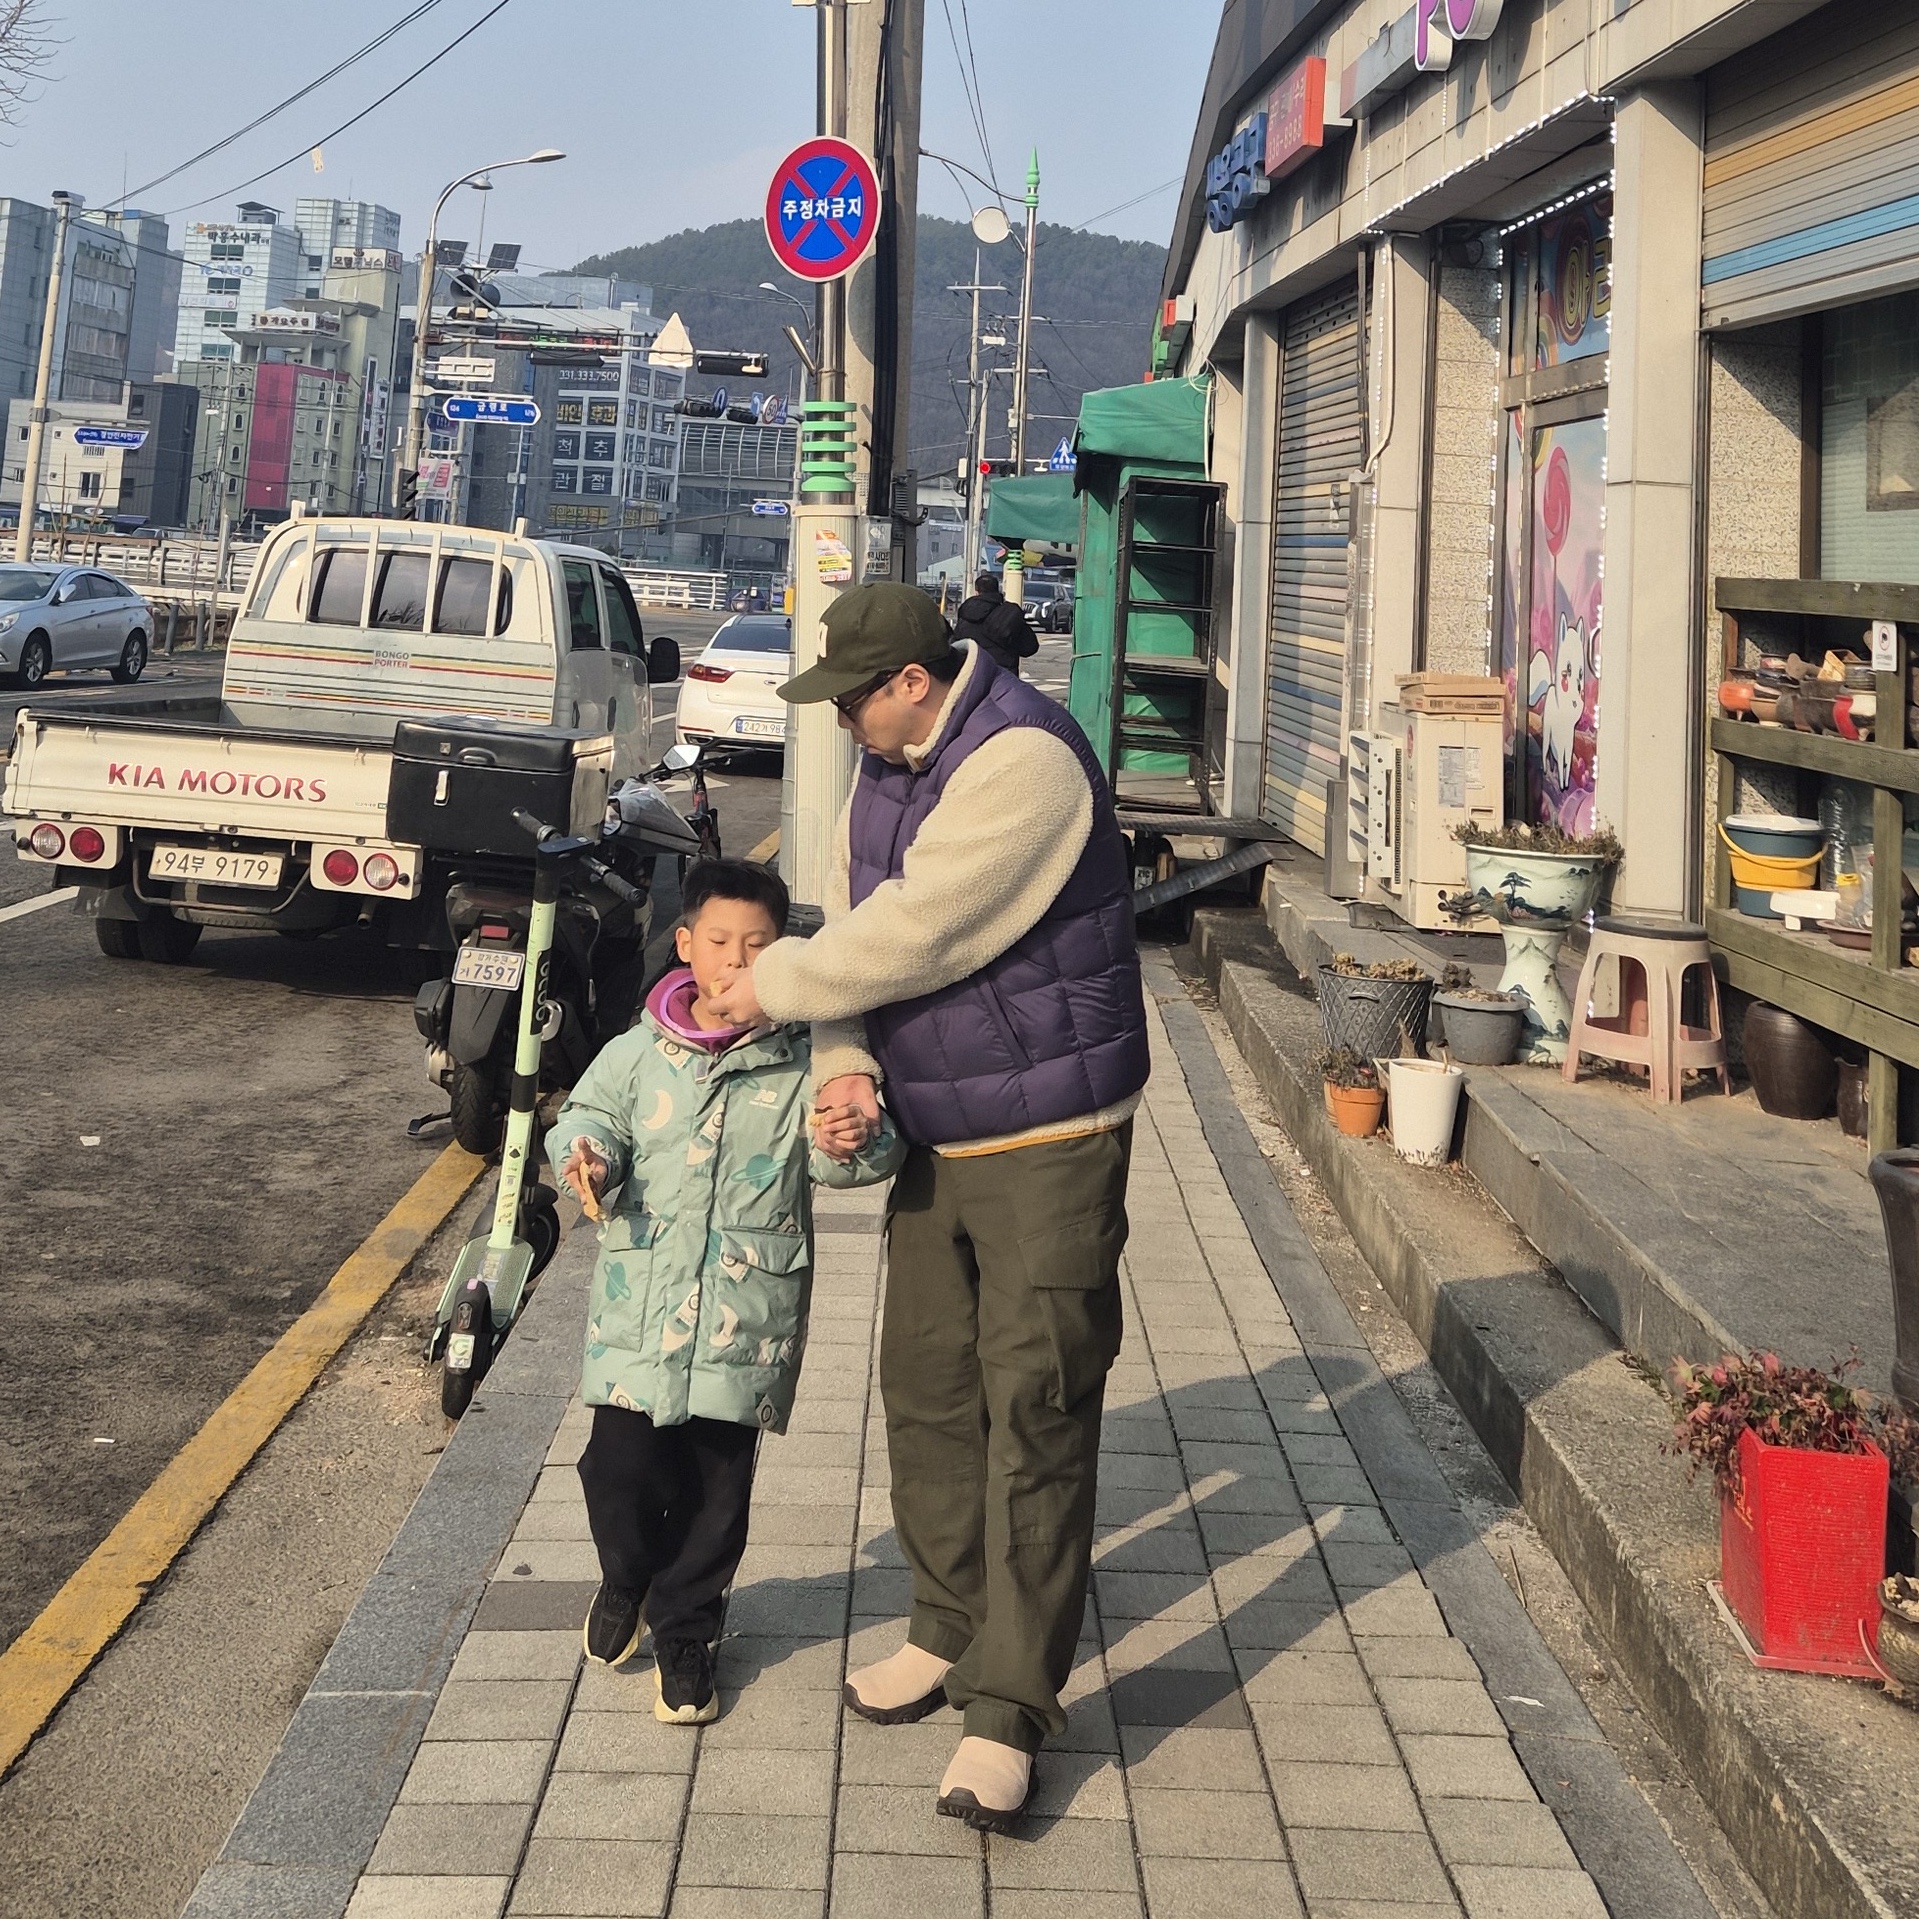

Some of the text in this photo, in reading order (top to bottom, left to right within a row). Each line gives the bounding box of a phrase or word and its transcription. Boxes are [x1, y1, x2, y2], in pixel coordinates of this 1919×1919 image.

[782, 196, 862, 220] 주정차금지
[766, 404, 777, 417] 50
[374, 659, 408, 668] PORTER
[375, 650, 409, 660] BONGO
[107, 763, 327, 802] KIA MOTORS
[164, 852, 269, 880] 94부 9179
[473, 963, 517, 983] 7597
